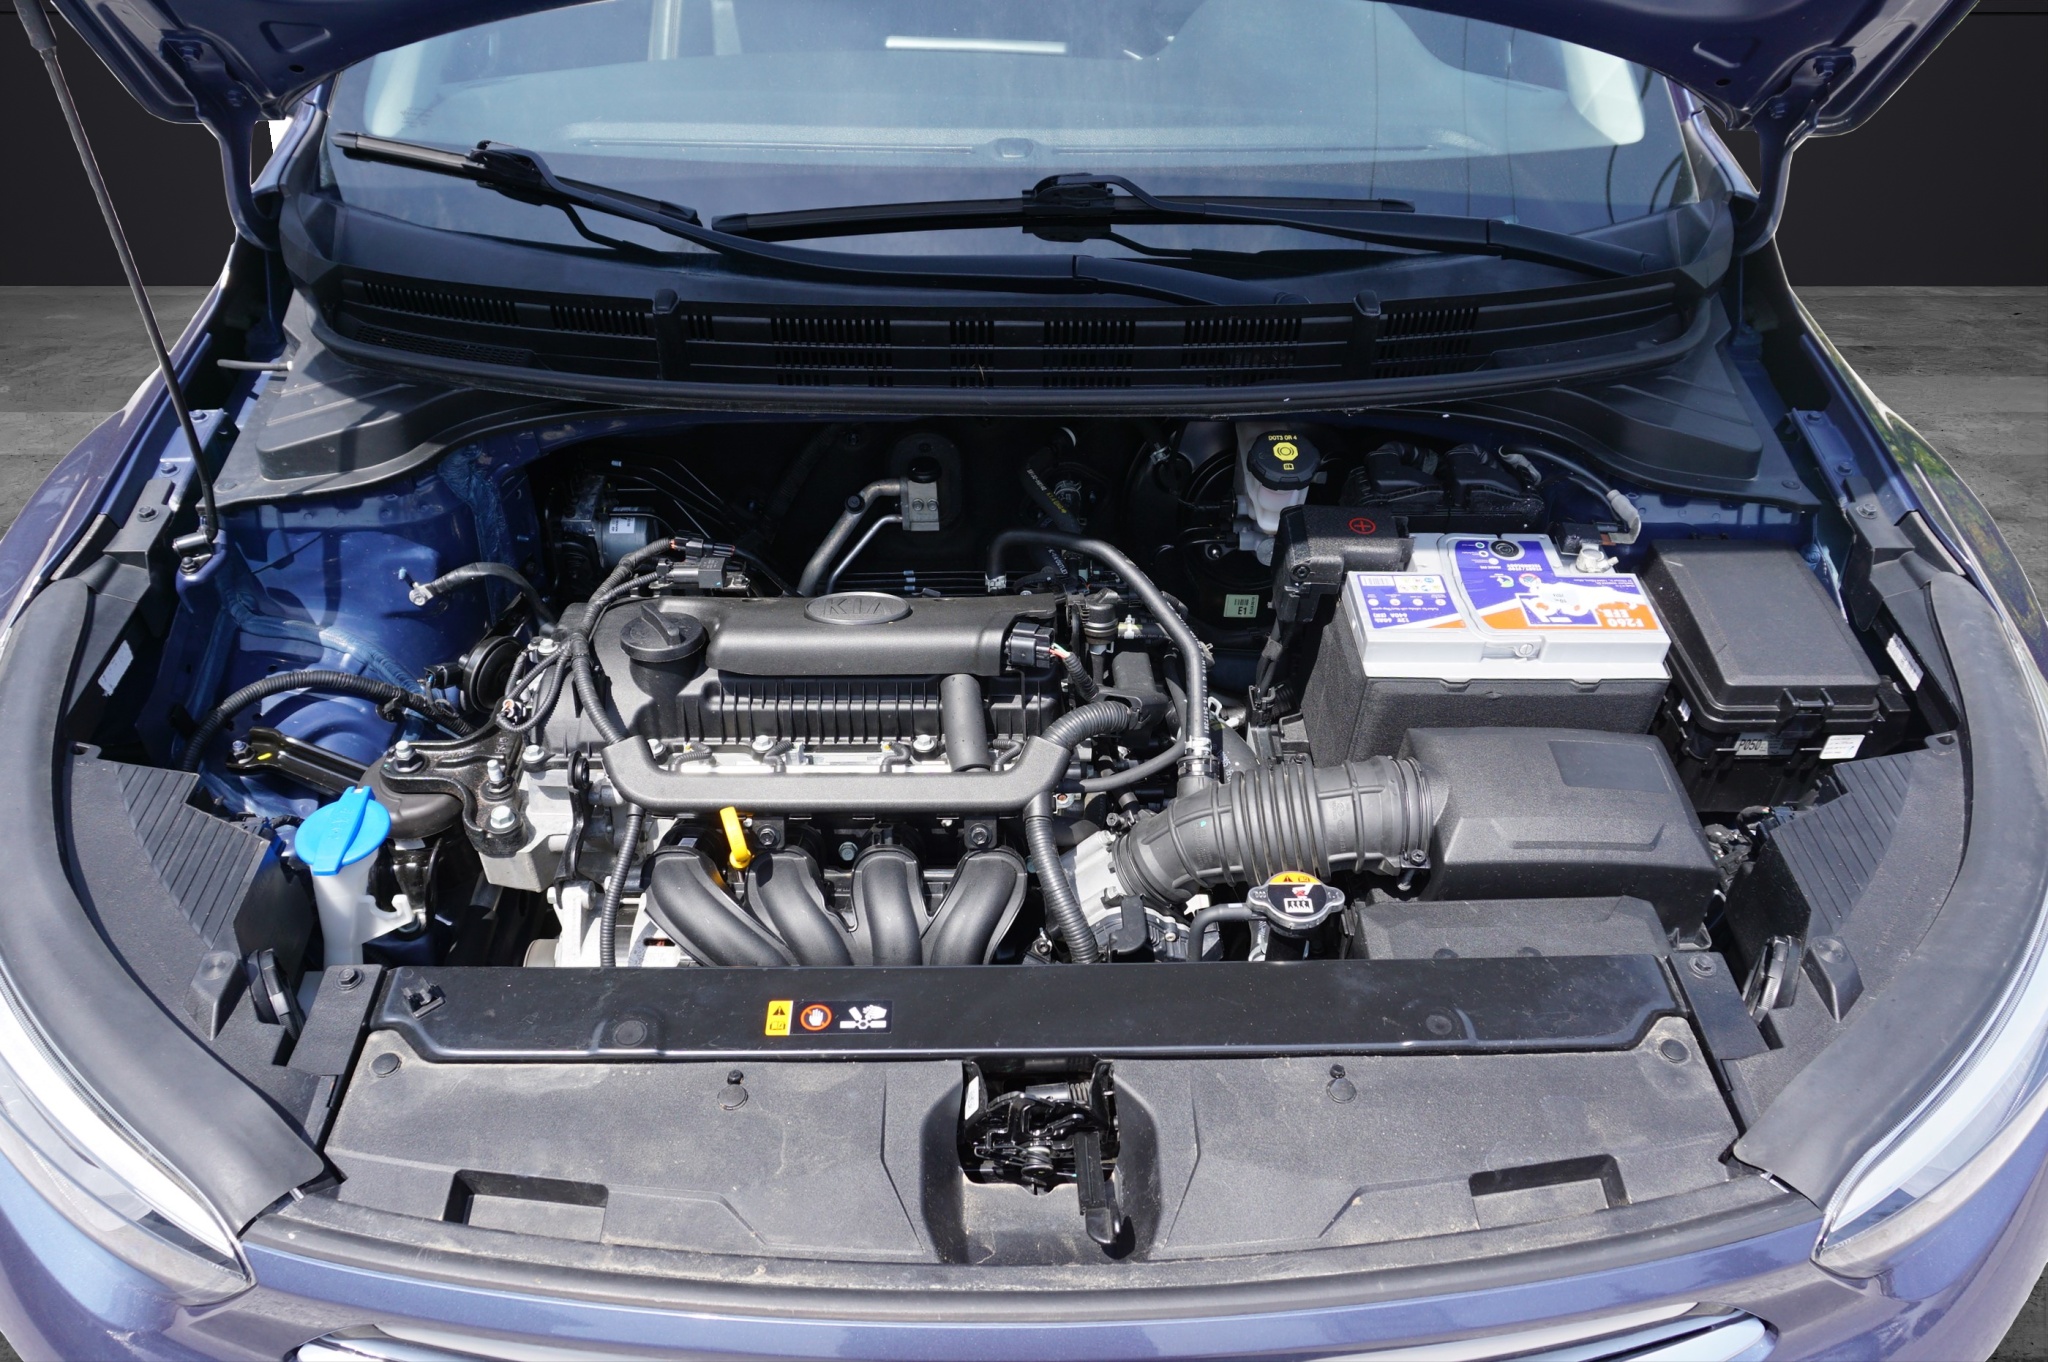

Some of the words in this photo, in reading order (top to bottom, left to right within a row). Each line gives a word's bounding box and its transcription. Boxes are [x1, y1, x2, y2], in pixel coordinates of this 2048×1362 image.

[823, 598, 892, 615] KIA
[1238, 606, 1247, 615] E1
[1607, 618, 1644, 627] F260
[1739, 738, 1763, 750] P050
